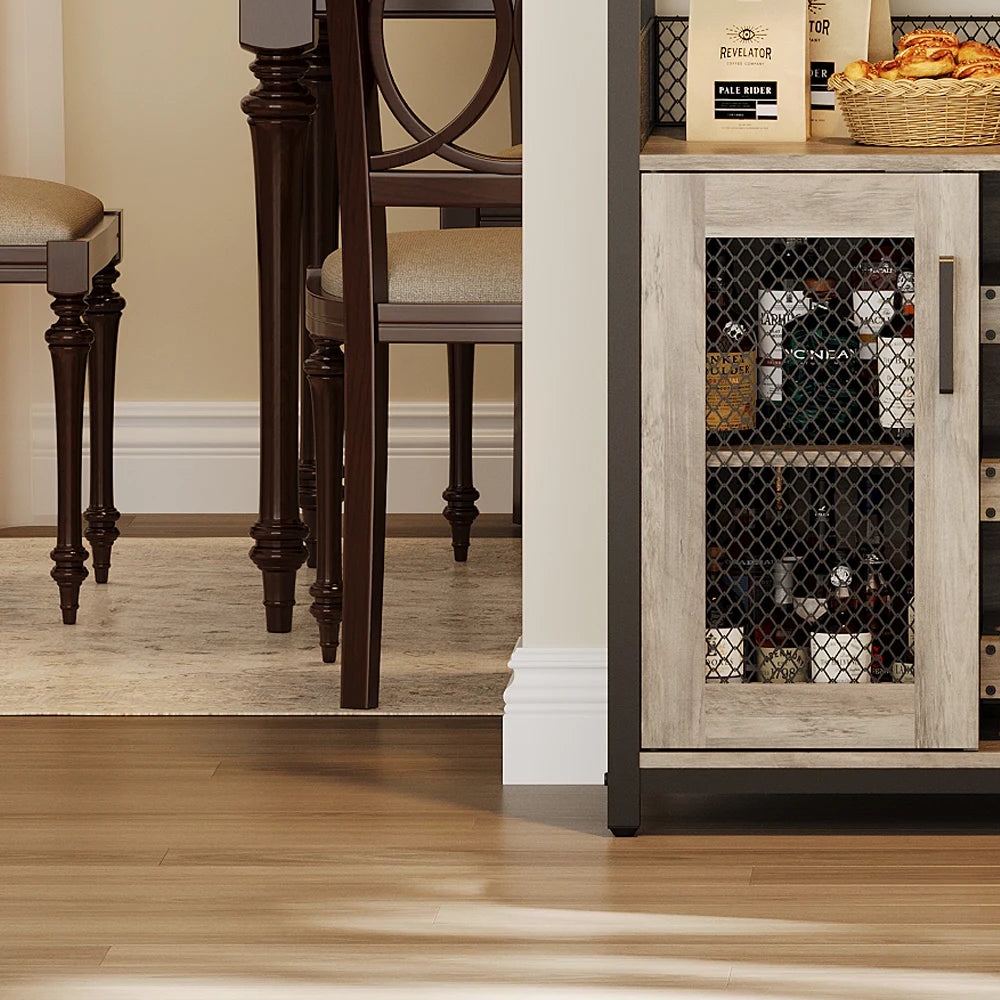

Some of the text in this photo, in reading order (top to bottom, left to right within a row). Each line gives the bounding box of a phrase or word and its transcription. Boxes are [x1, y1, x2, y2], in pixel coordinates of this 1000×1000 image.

[809, 19, 830, 35] TOR
[720, 46, 772, 60] REVELATOR
[718, 86, 772, 95] PALE RIDER
